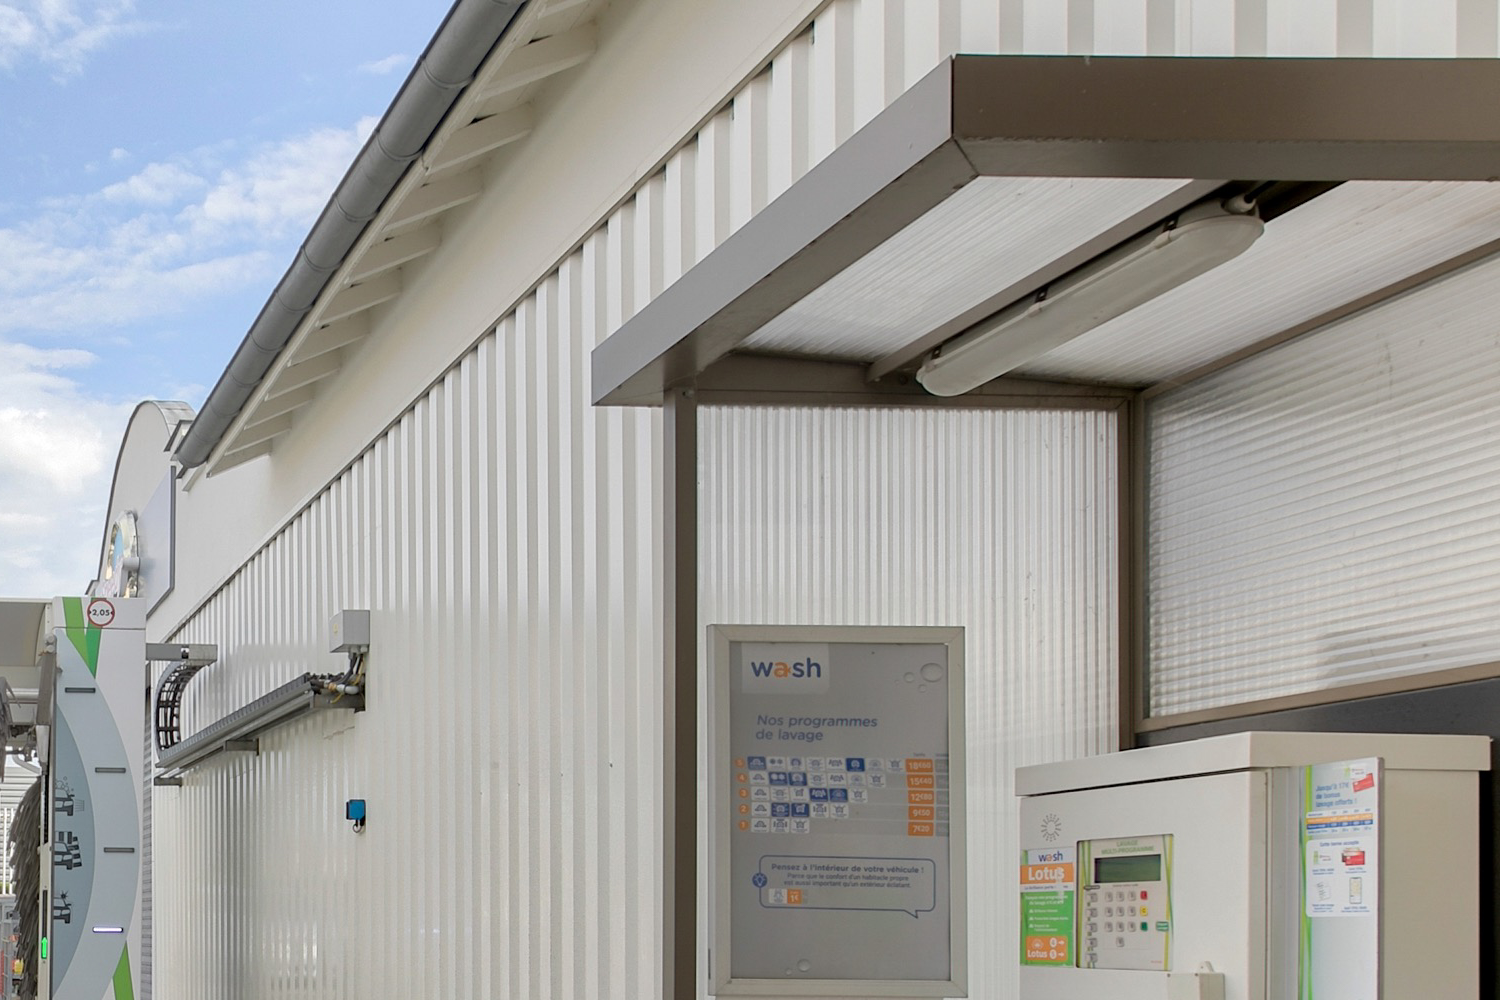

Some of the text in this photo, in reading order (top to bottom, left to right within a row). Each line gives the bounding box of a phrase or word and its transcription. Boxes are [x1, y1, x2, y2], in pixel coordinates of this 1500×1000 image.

[92, 609, 110, 617] 2,05
[751, 657, 821, 678] wash
[757, 715, 878, 728] Nos programmes
[755, 729, 824, 743] de lavage
[1038, 851, 1063, 862] wash
[1028, 949, 1048, 959] Lotus
